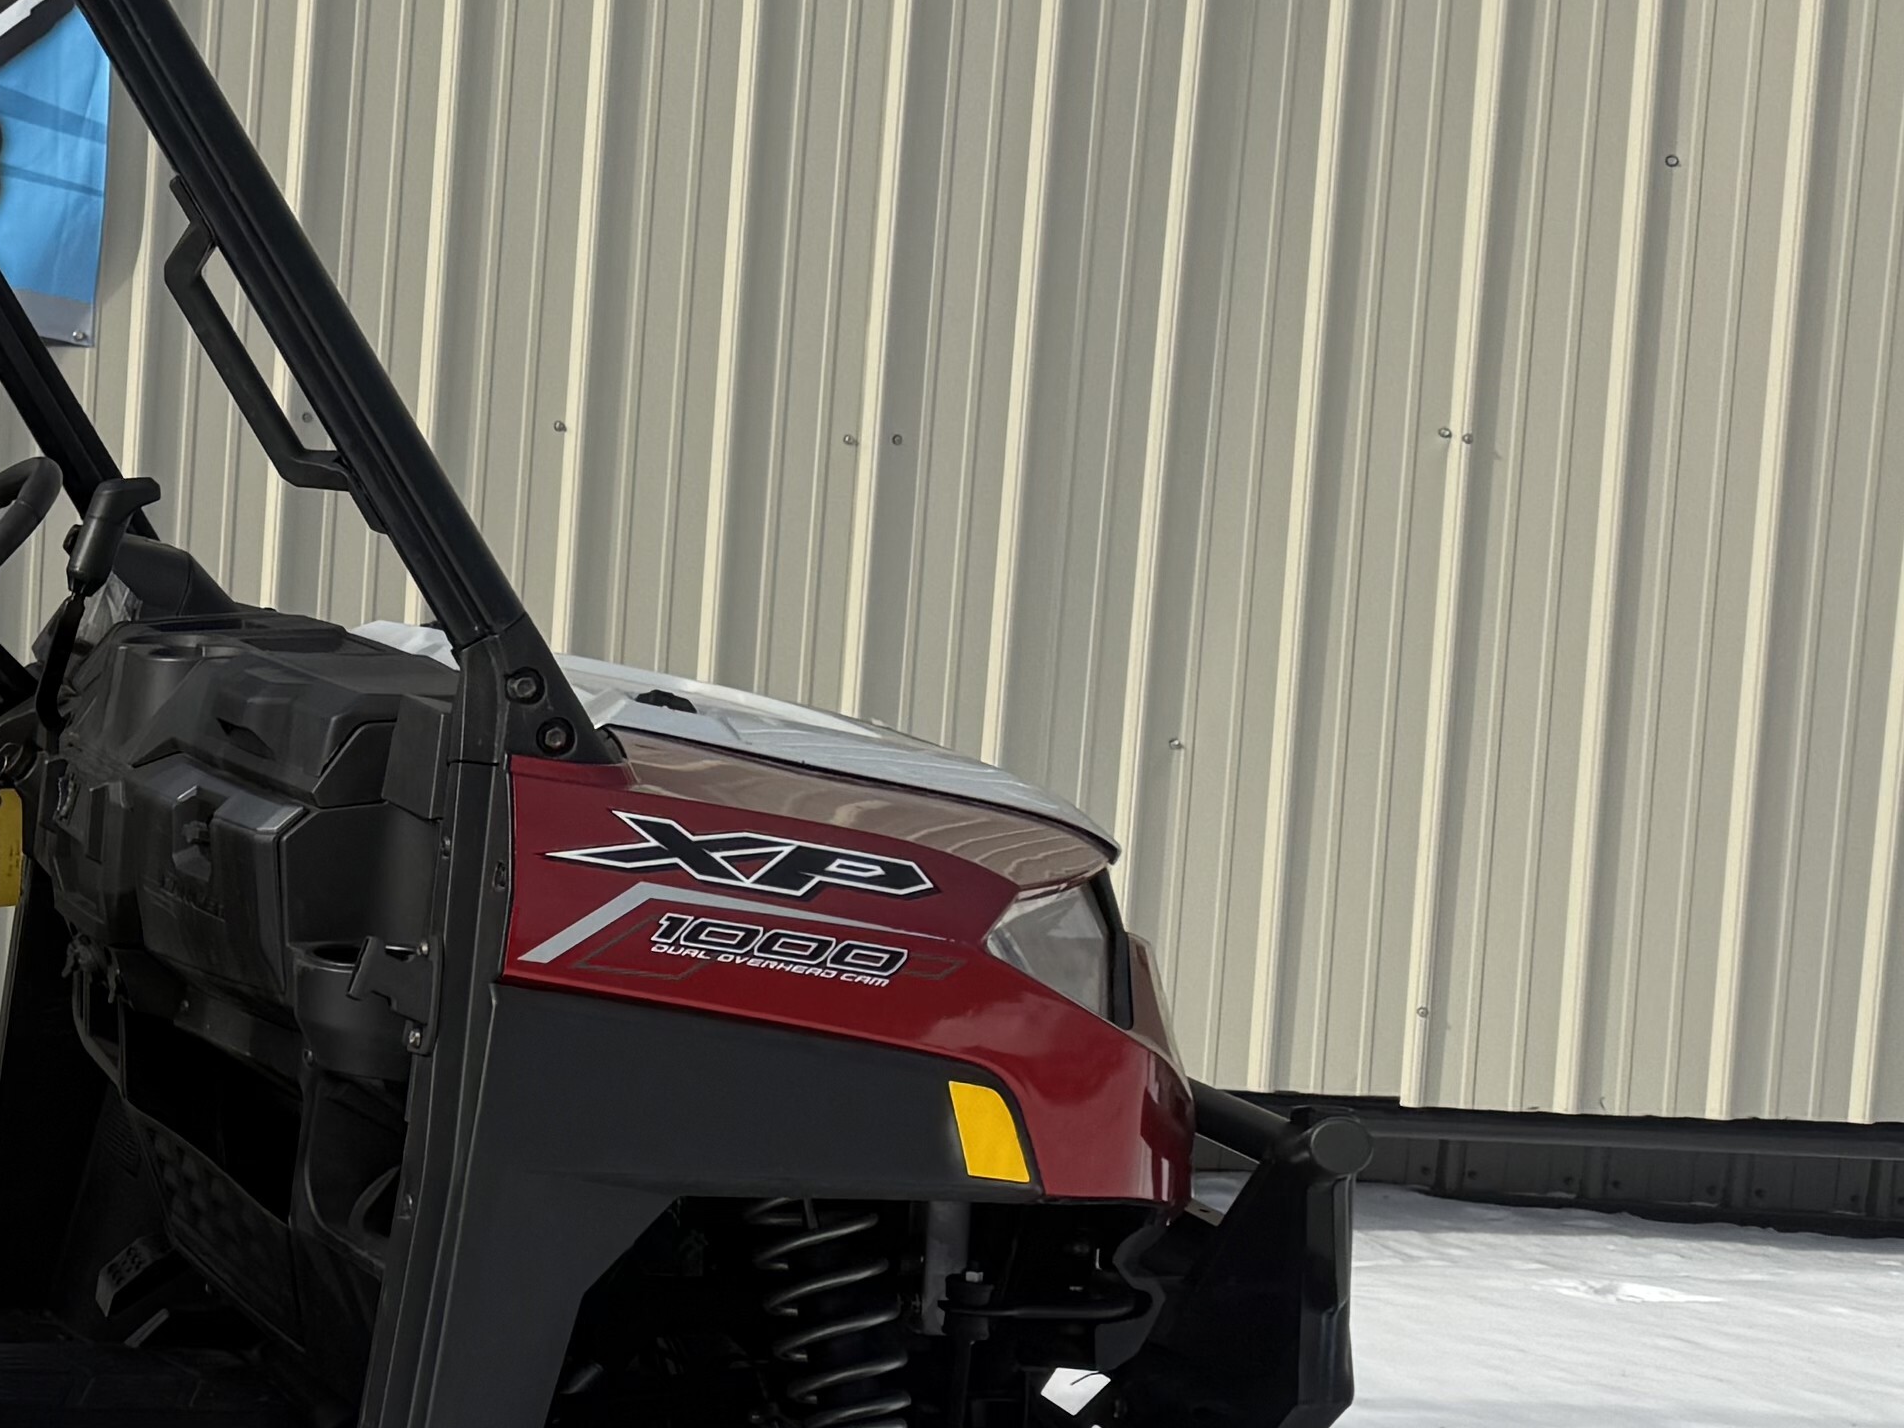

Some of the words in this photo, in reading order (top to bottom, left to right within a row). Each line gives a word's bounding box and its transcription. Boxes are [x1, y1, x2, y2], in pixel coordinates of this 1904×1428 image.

[545, 809, 938, 897] XP
[650, 912, 909, 977] 1000
[651, 944, 711, 961] DUAL
[717, 952, 838, 979] OVERHEAD
[840, 972, 890, 988] CAM
